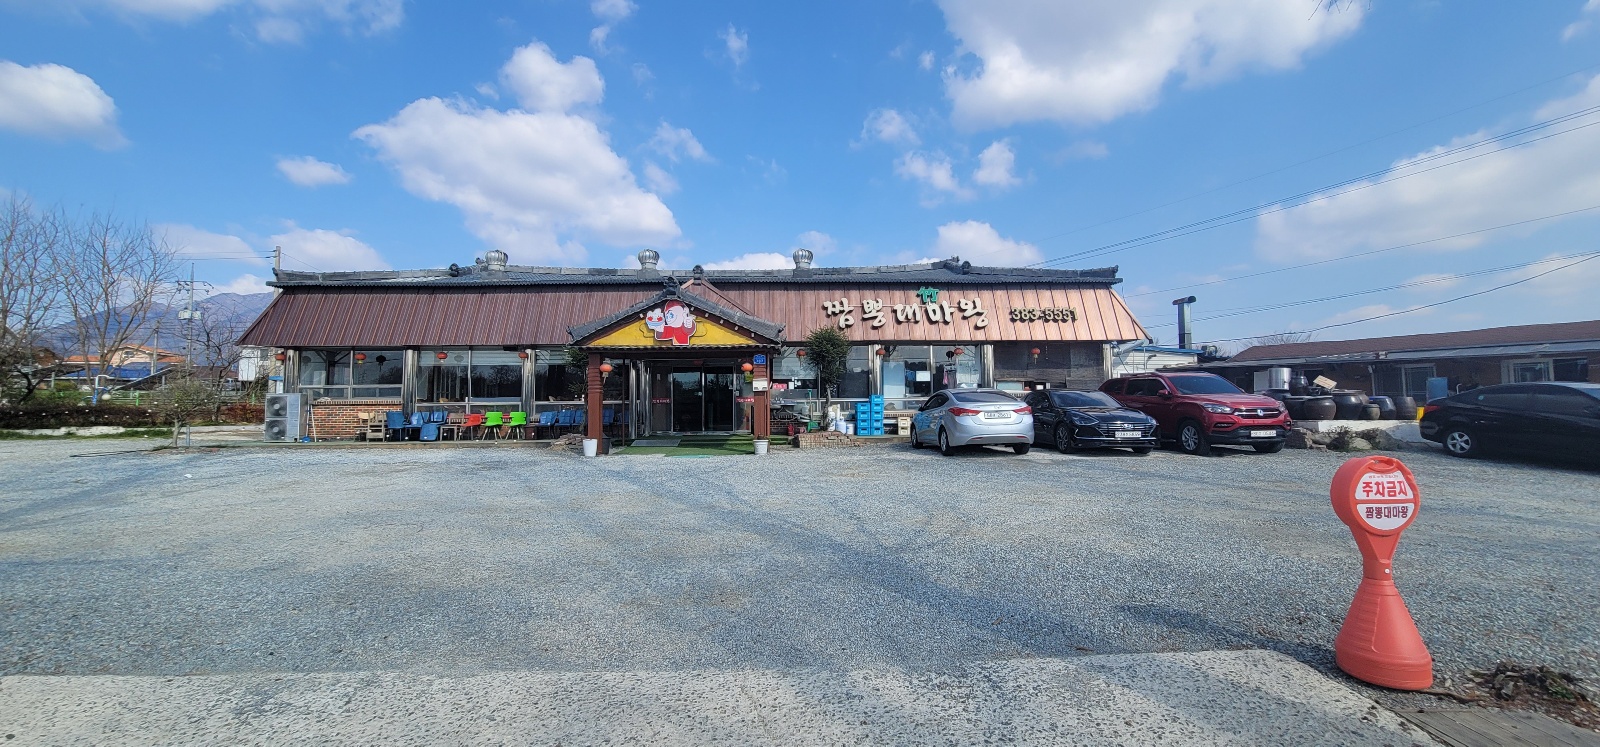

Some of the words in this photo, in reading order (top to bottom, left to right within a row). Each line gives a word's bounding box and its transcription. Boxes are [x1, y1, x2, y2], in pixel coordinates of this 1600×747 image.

[918, 286, 939, 302] 竹
[824, 297, 989, 328] 짬뽕대마왕
[1011, 307, 1078, 321] 383-5551
[1362, 480, 1408, 497] 주차금지
[1365, 506, 1408, 519] 짬뽕대마왕
